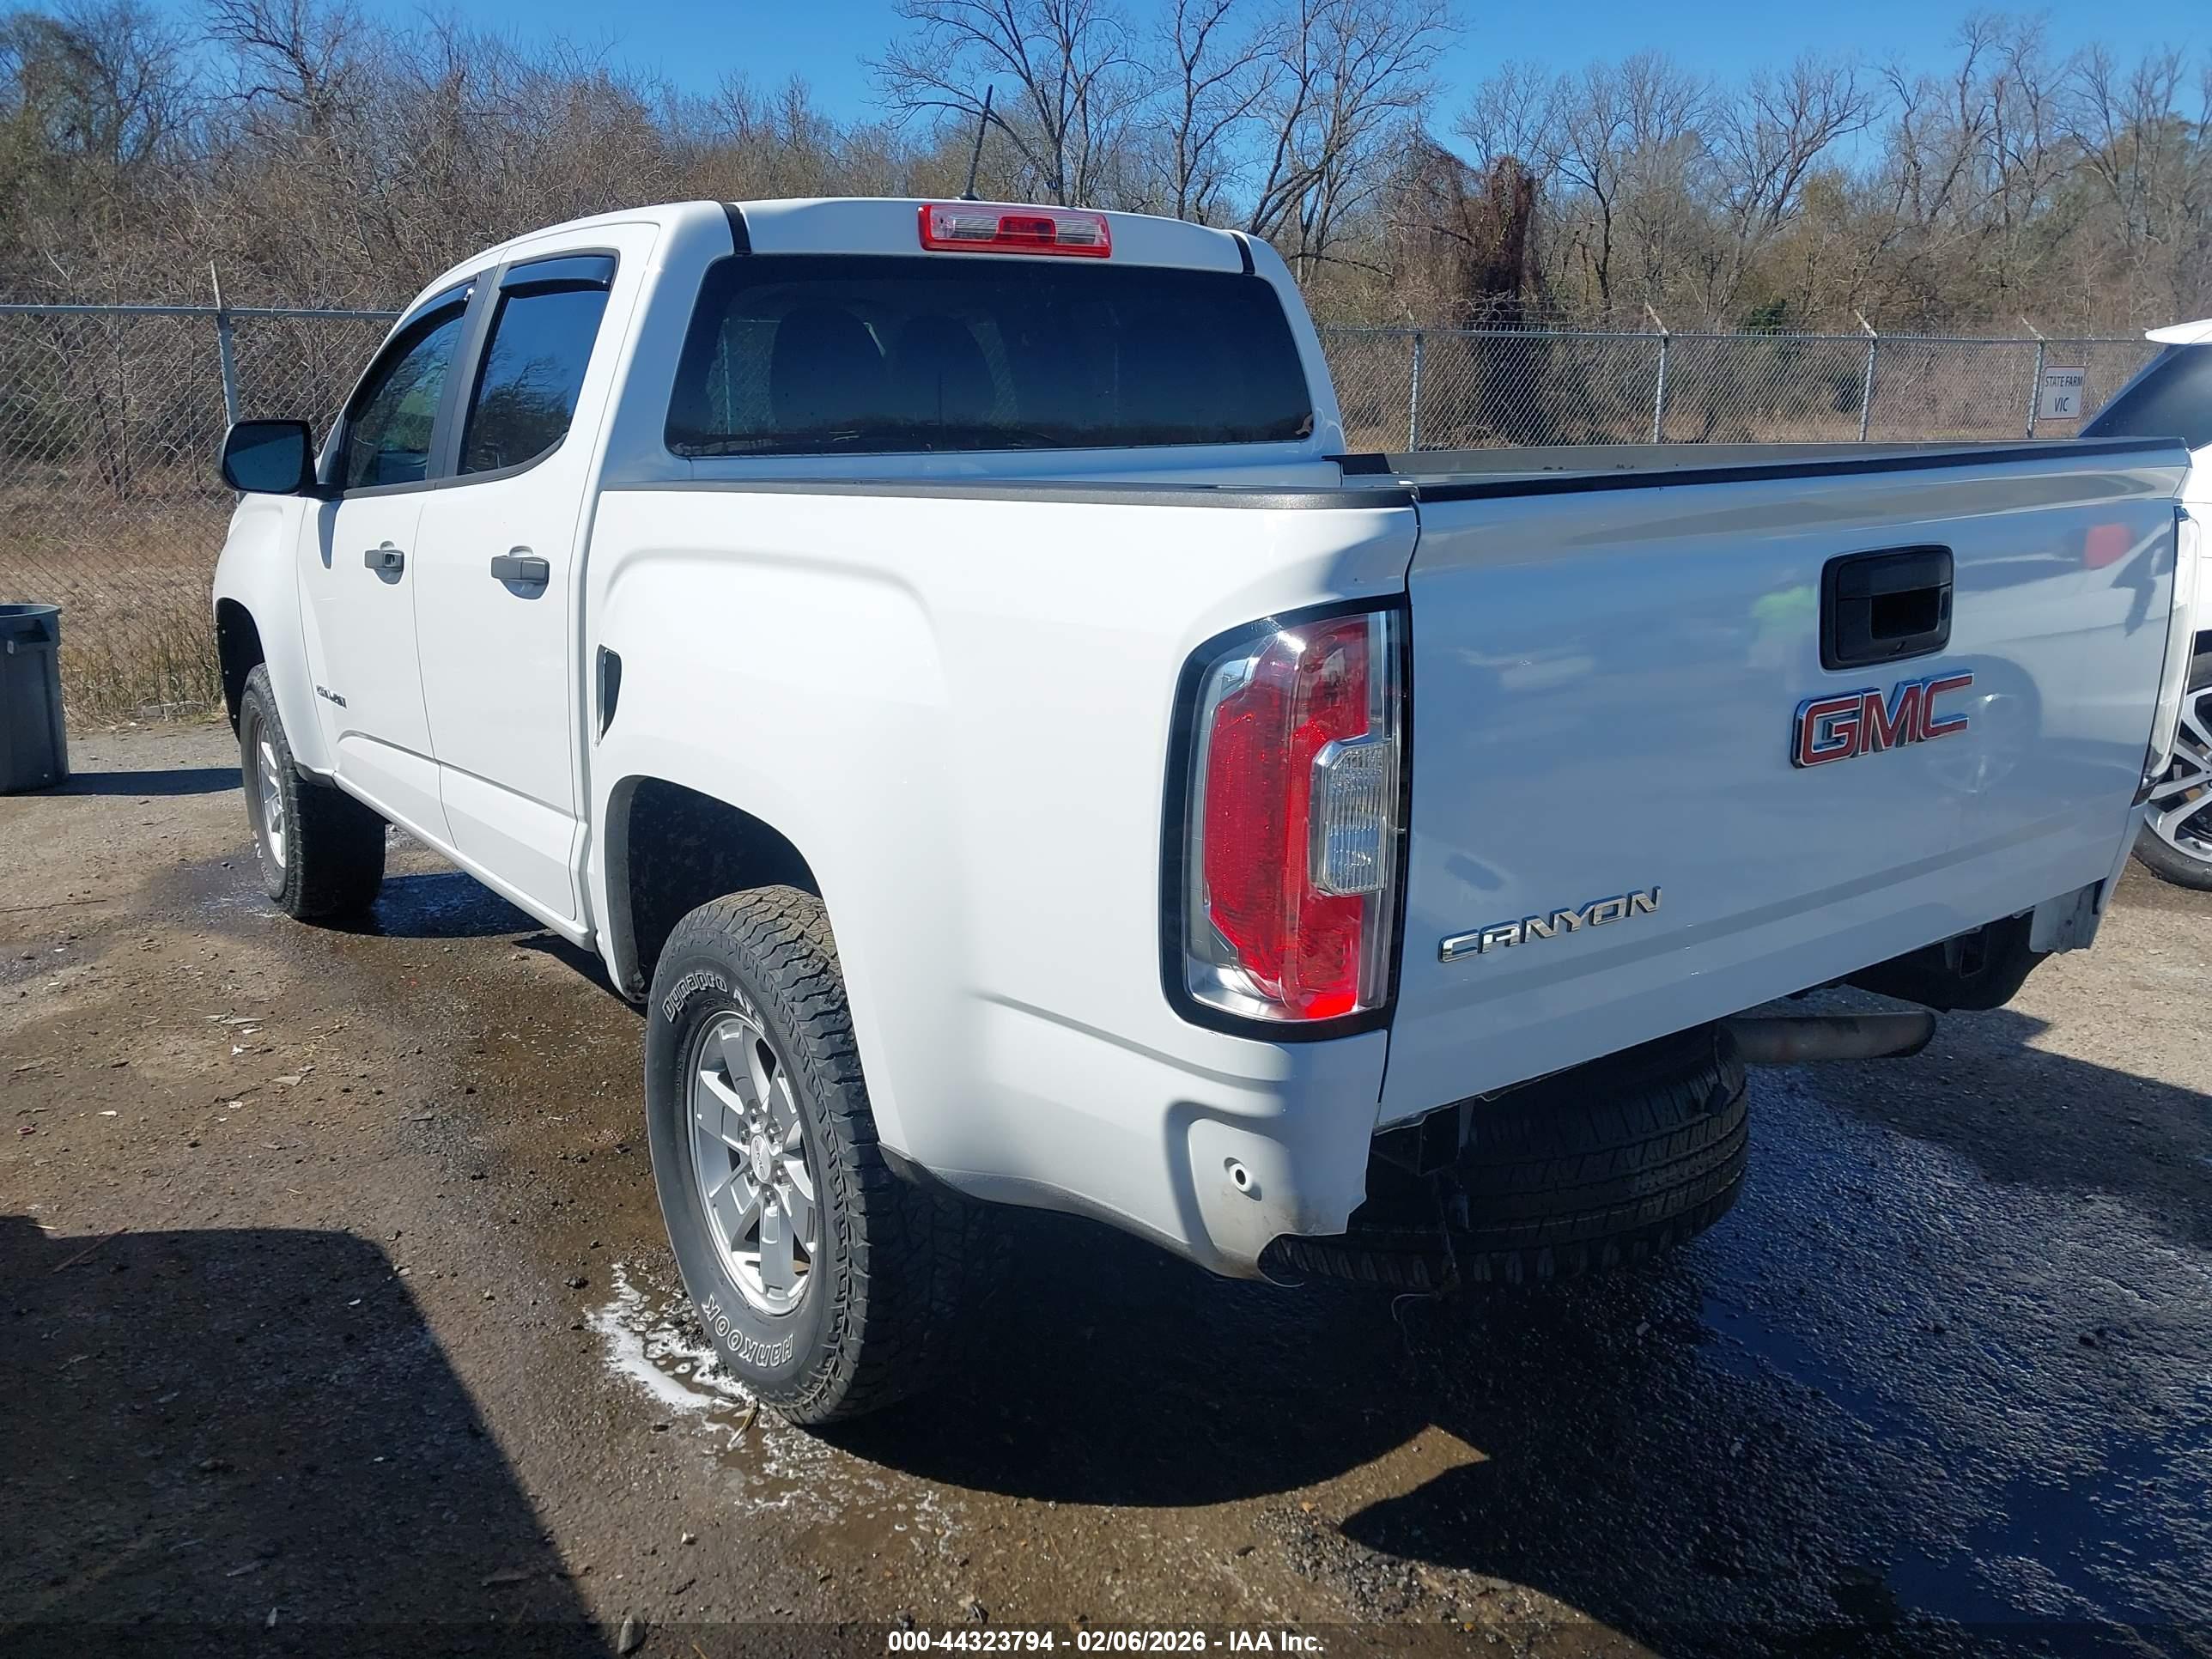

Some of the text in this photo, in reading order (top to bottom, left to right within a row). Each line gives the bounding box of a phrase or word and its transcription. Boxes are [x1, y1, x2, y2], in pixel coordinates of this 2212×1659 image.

[2045, 375, 2083, 387] STATE FARM
[2054, 397, 2069, 413] VIC
[1790, 669, 1974, 769] GMC
[1437, 885, 1662, 963] CANYON
[662, 971, 728, 1024] Dynapro
